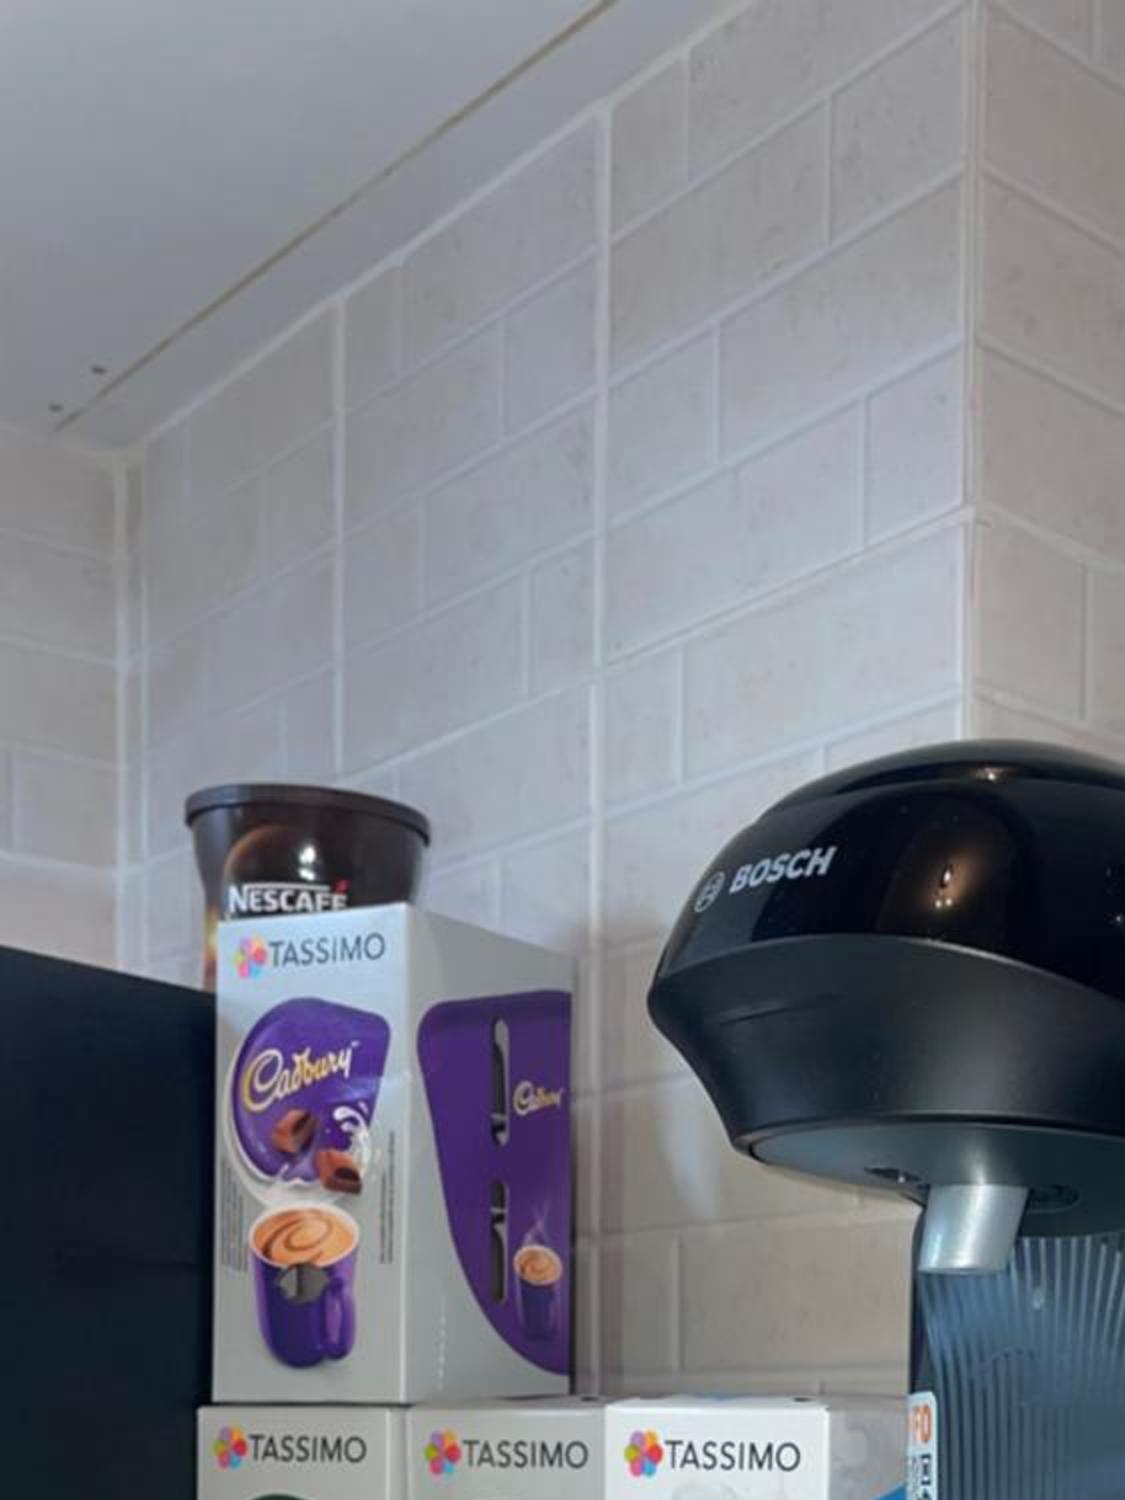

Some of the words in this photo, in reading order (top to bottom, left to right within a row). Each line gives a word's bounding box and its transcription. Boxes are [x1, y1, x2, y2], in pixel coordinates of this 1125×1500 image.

[729, 845, 837, 894] BOSCH
[269, 932, 386, 967] TASSIMO
[242, 1047, 353, 1113] Cadbury
[249, 1434, 367, 1463] TASSIMO
[463, 1439, 589, 1469] TASSIMO
[665, 1440, 801, 1471] TASSIMO
